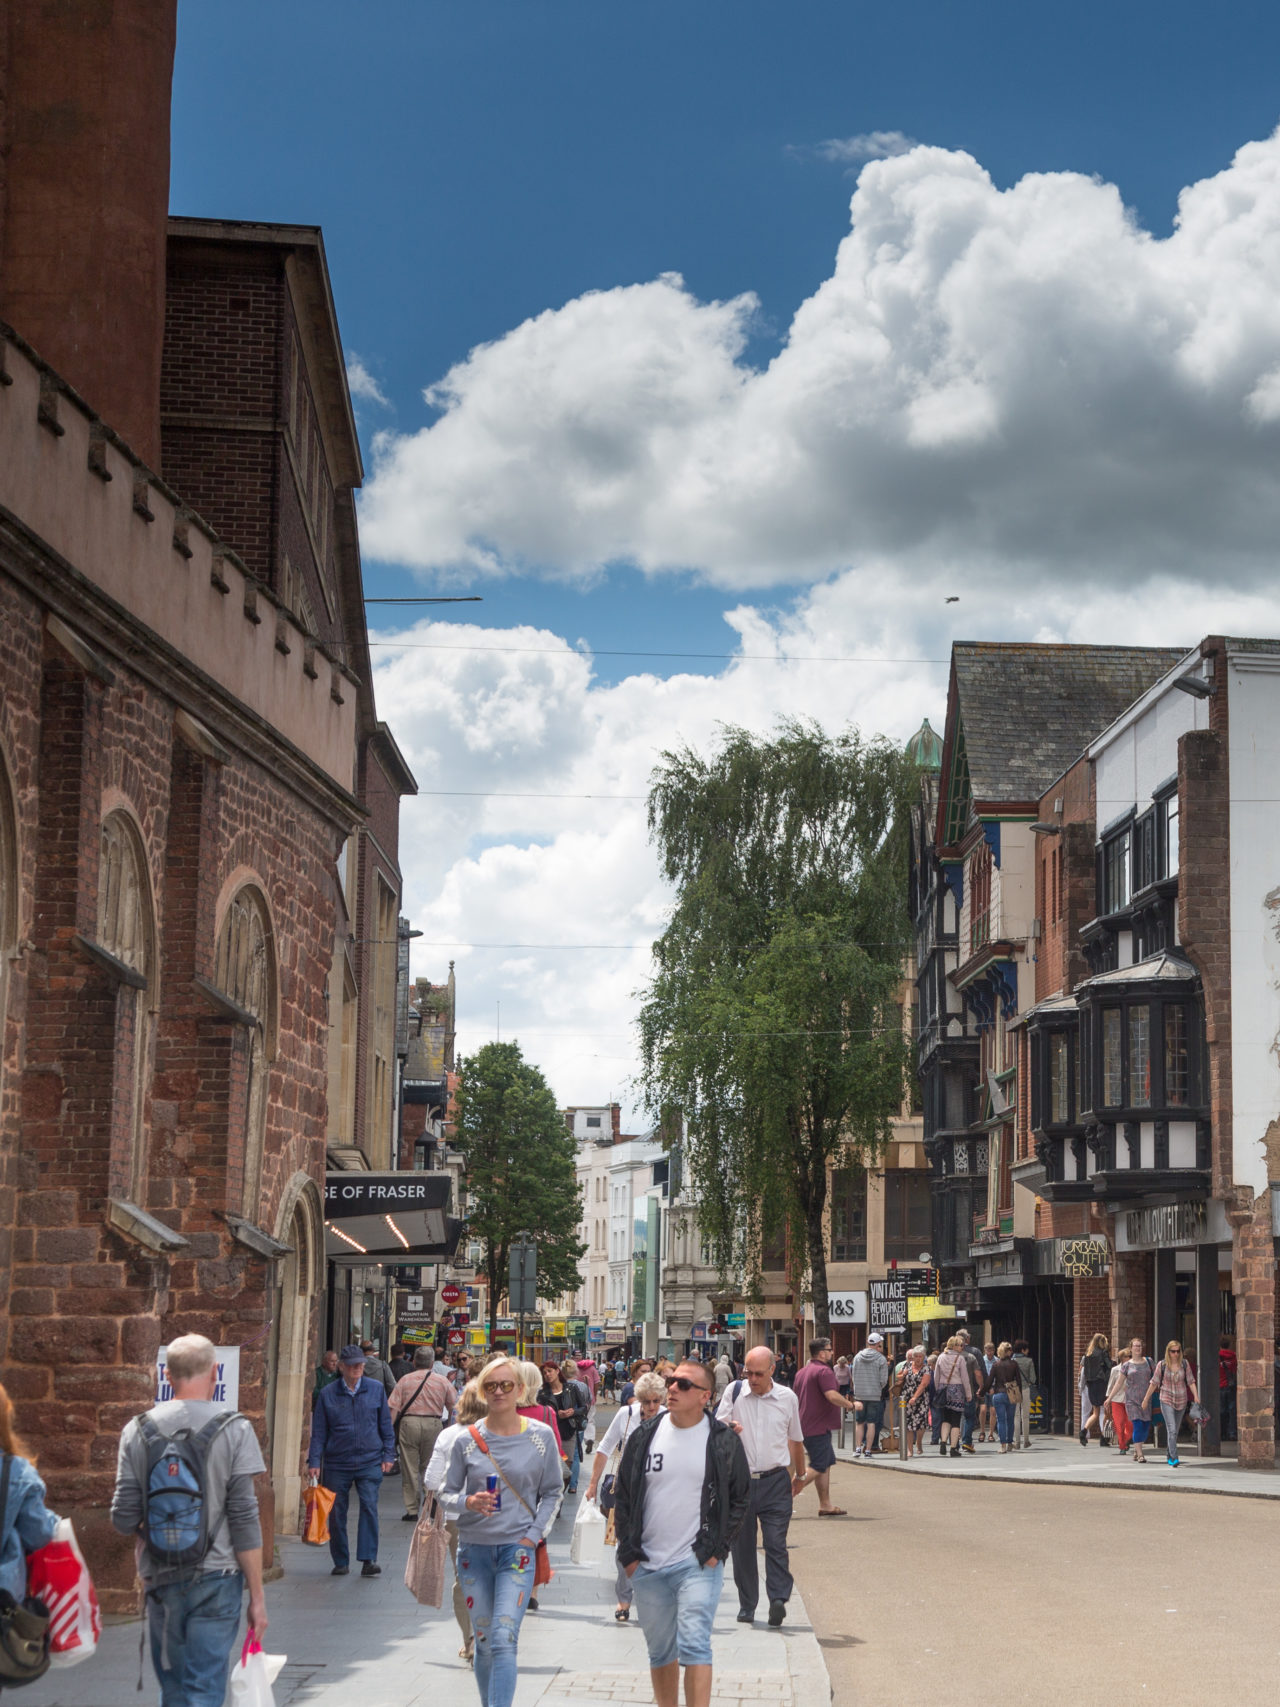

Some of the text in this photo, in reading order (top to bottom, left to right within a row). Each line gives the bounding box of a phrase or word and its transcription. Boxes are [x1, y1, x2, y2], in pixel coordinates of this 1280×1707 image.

[324, 1185, 426, 1199] SE OF FRASER
[1061, 1240, 1108, 1254] URBAN
[1063, 1252, 1107, 1266] OUTFIT
[1065, 1264, 1093, 1277] TERS
[870, 1281, 906, 1299] VINTAGE
[871, 1301, 906, 1314] REWORKED
[871, 1313, 906, 1326] CLOTHING
